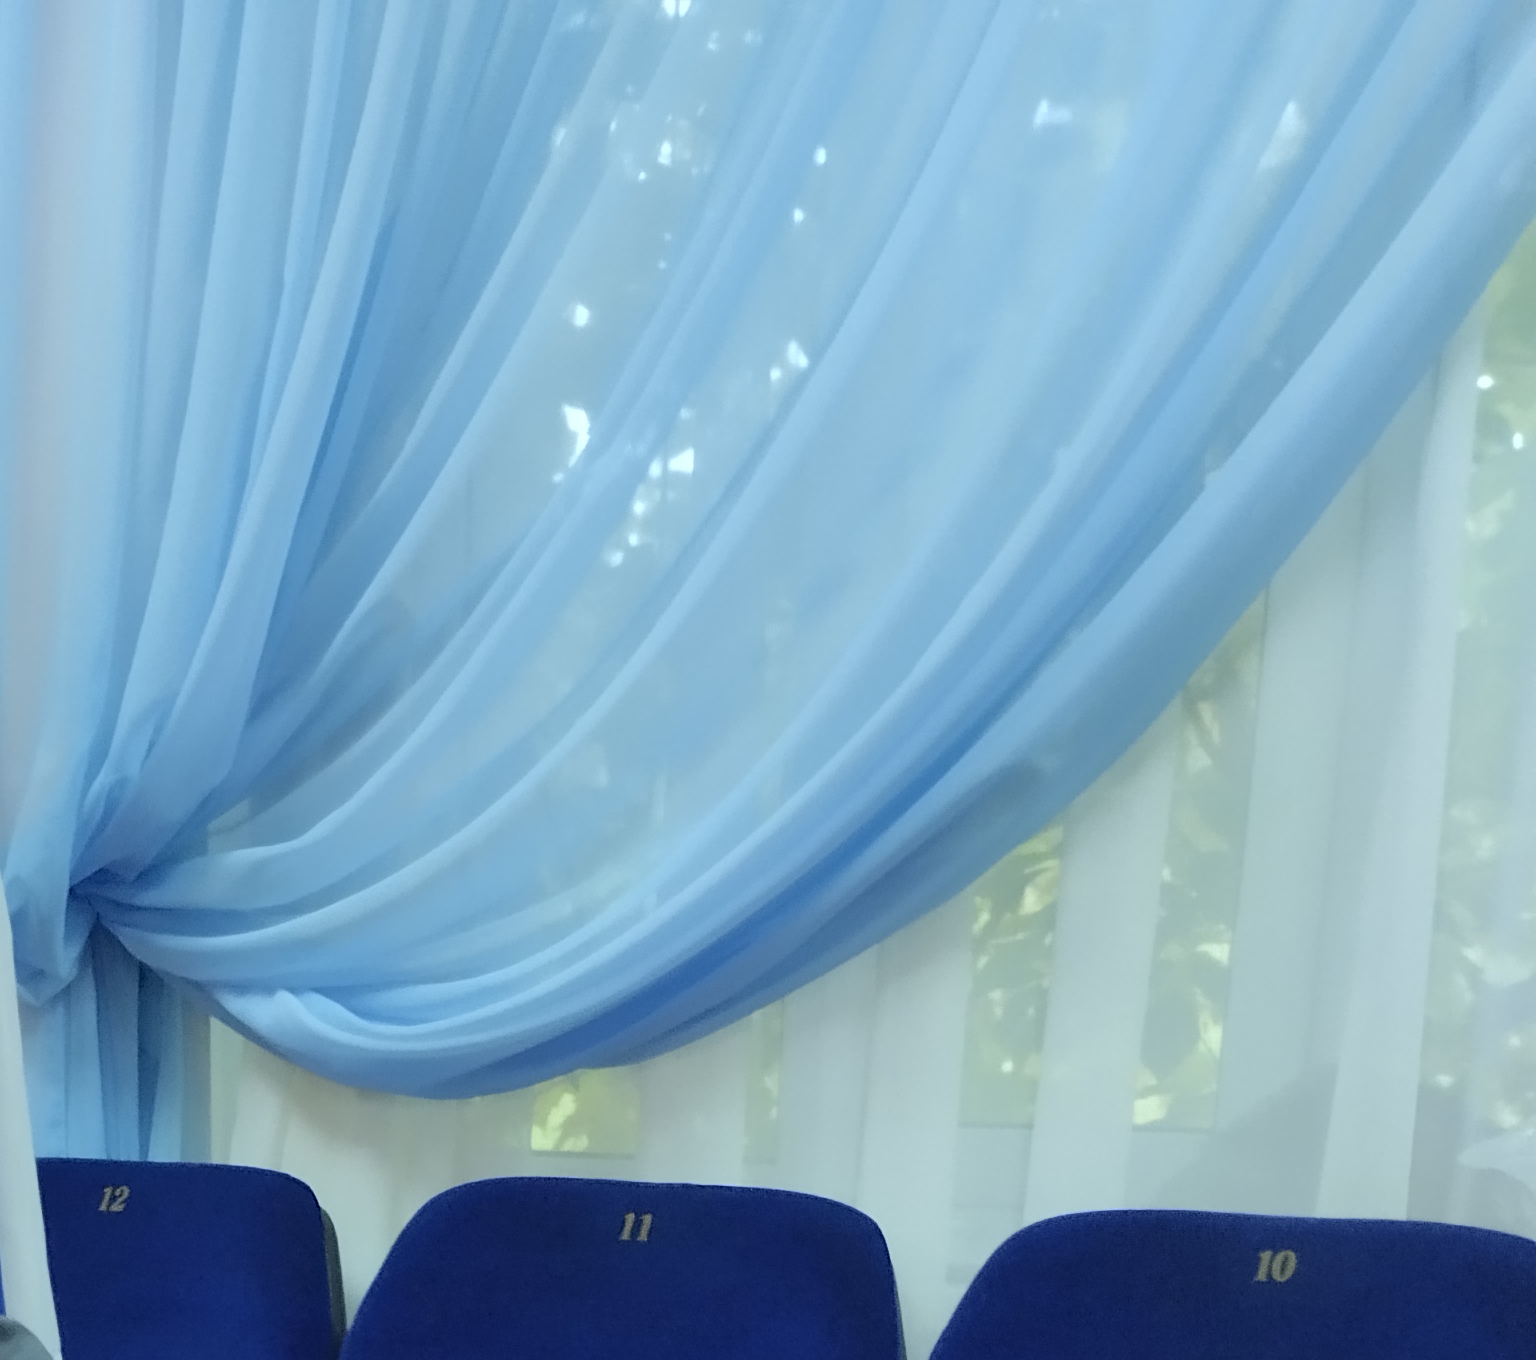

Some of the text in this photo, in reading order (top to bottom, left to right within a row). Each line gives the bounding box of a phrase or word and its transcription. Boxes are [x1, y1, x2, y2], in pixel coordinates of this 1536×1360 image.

[98, 1185, 131, 1212] 12
[618, 1212, 653, 1241] 11
[1254, 1249, 1297, 1282] 10
